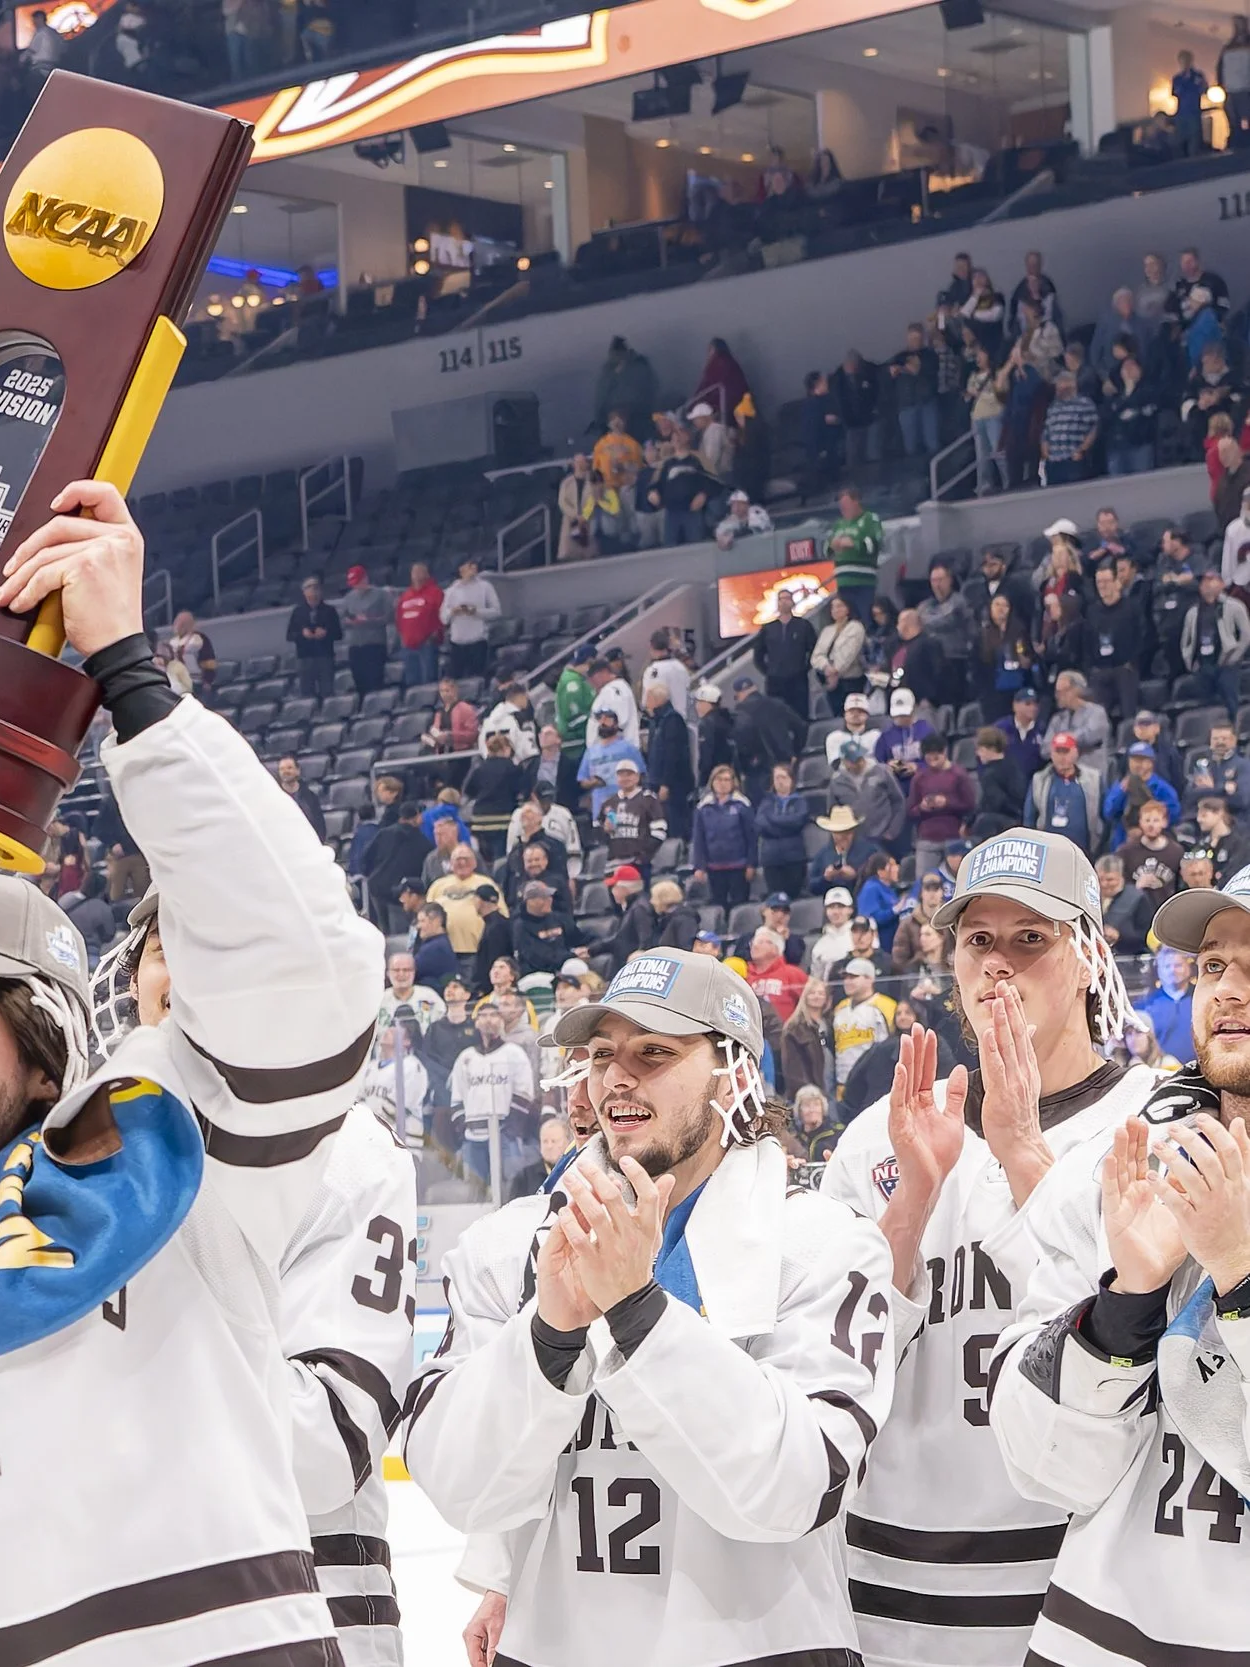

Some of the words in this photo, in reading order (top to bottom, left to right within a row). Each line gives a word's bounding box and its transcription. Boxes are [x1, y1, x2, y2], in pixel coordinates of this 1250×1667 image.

[5, 191, 148, 266] NCAA
[439, 347, 473, 373] 114
[489, 336, 522, 364] 115
[3, 368, 53, 398] 2025
[983, 840, 1040, 862] NATIONAL
[979, 856, 1039, 877] CHAMPIONS
[620, 959, 670, 977] NATIONAL
[612, 972, 668, 993] CHAMPIONS
[873, 1165, 901, 1182] NC
[351, 1214, 418, 1337] 3
[926, 1240, 1012, 1325] RON
[1154, 1432, 1245, 1544] 24
[571, 1476, 661, 1576] 12
